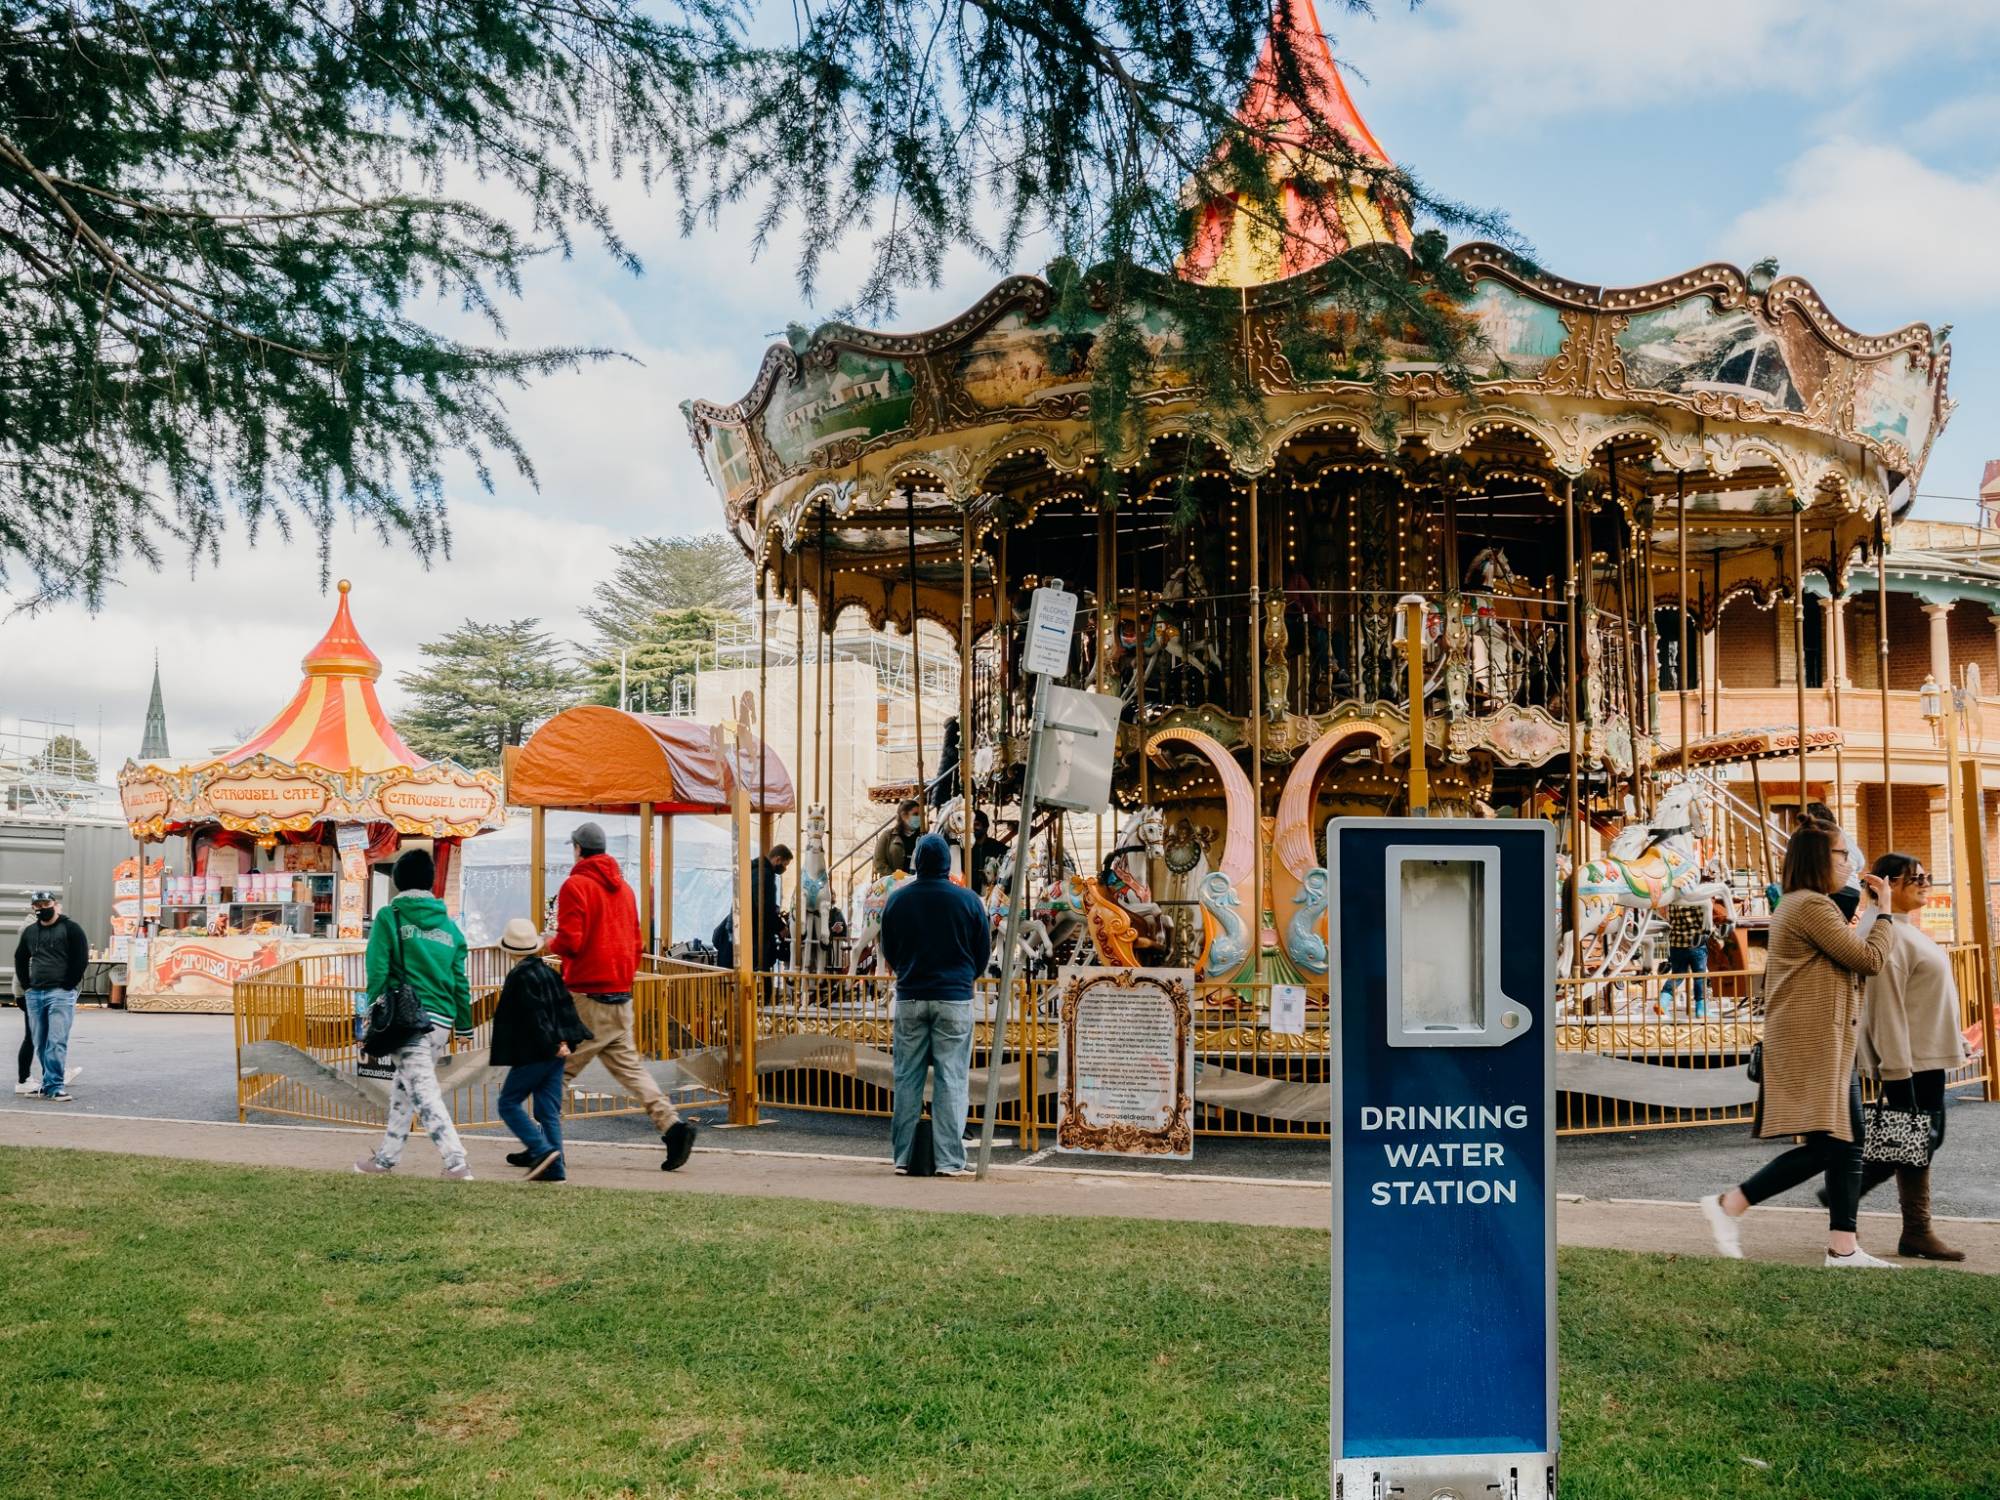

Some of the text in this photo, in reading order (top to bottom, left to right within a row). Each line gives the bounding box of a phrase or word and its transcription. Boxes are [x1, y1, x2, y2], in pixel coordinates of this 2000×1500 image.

[212, 787, 320, 800] CAROUSEL CAFE
[388, 792, 488, 809] CAROUSEL CAFE
[172, 951, 228, 979] Carousel
[1361, 1105, 1528, 1131] DRINKING
[1384, 1142, 1505, 1168] WATER
[1371, 1179, 1517, 1206] STATION
